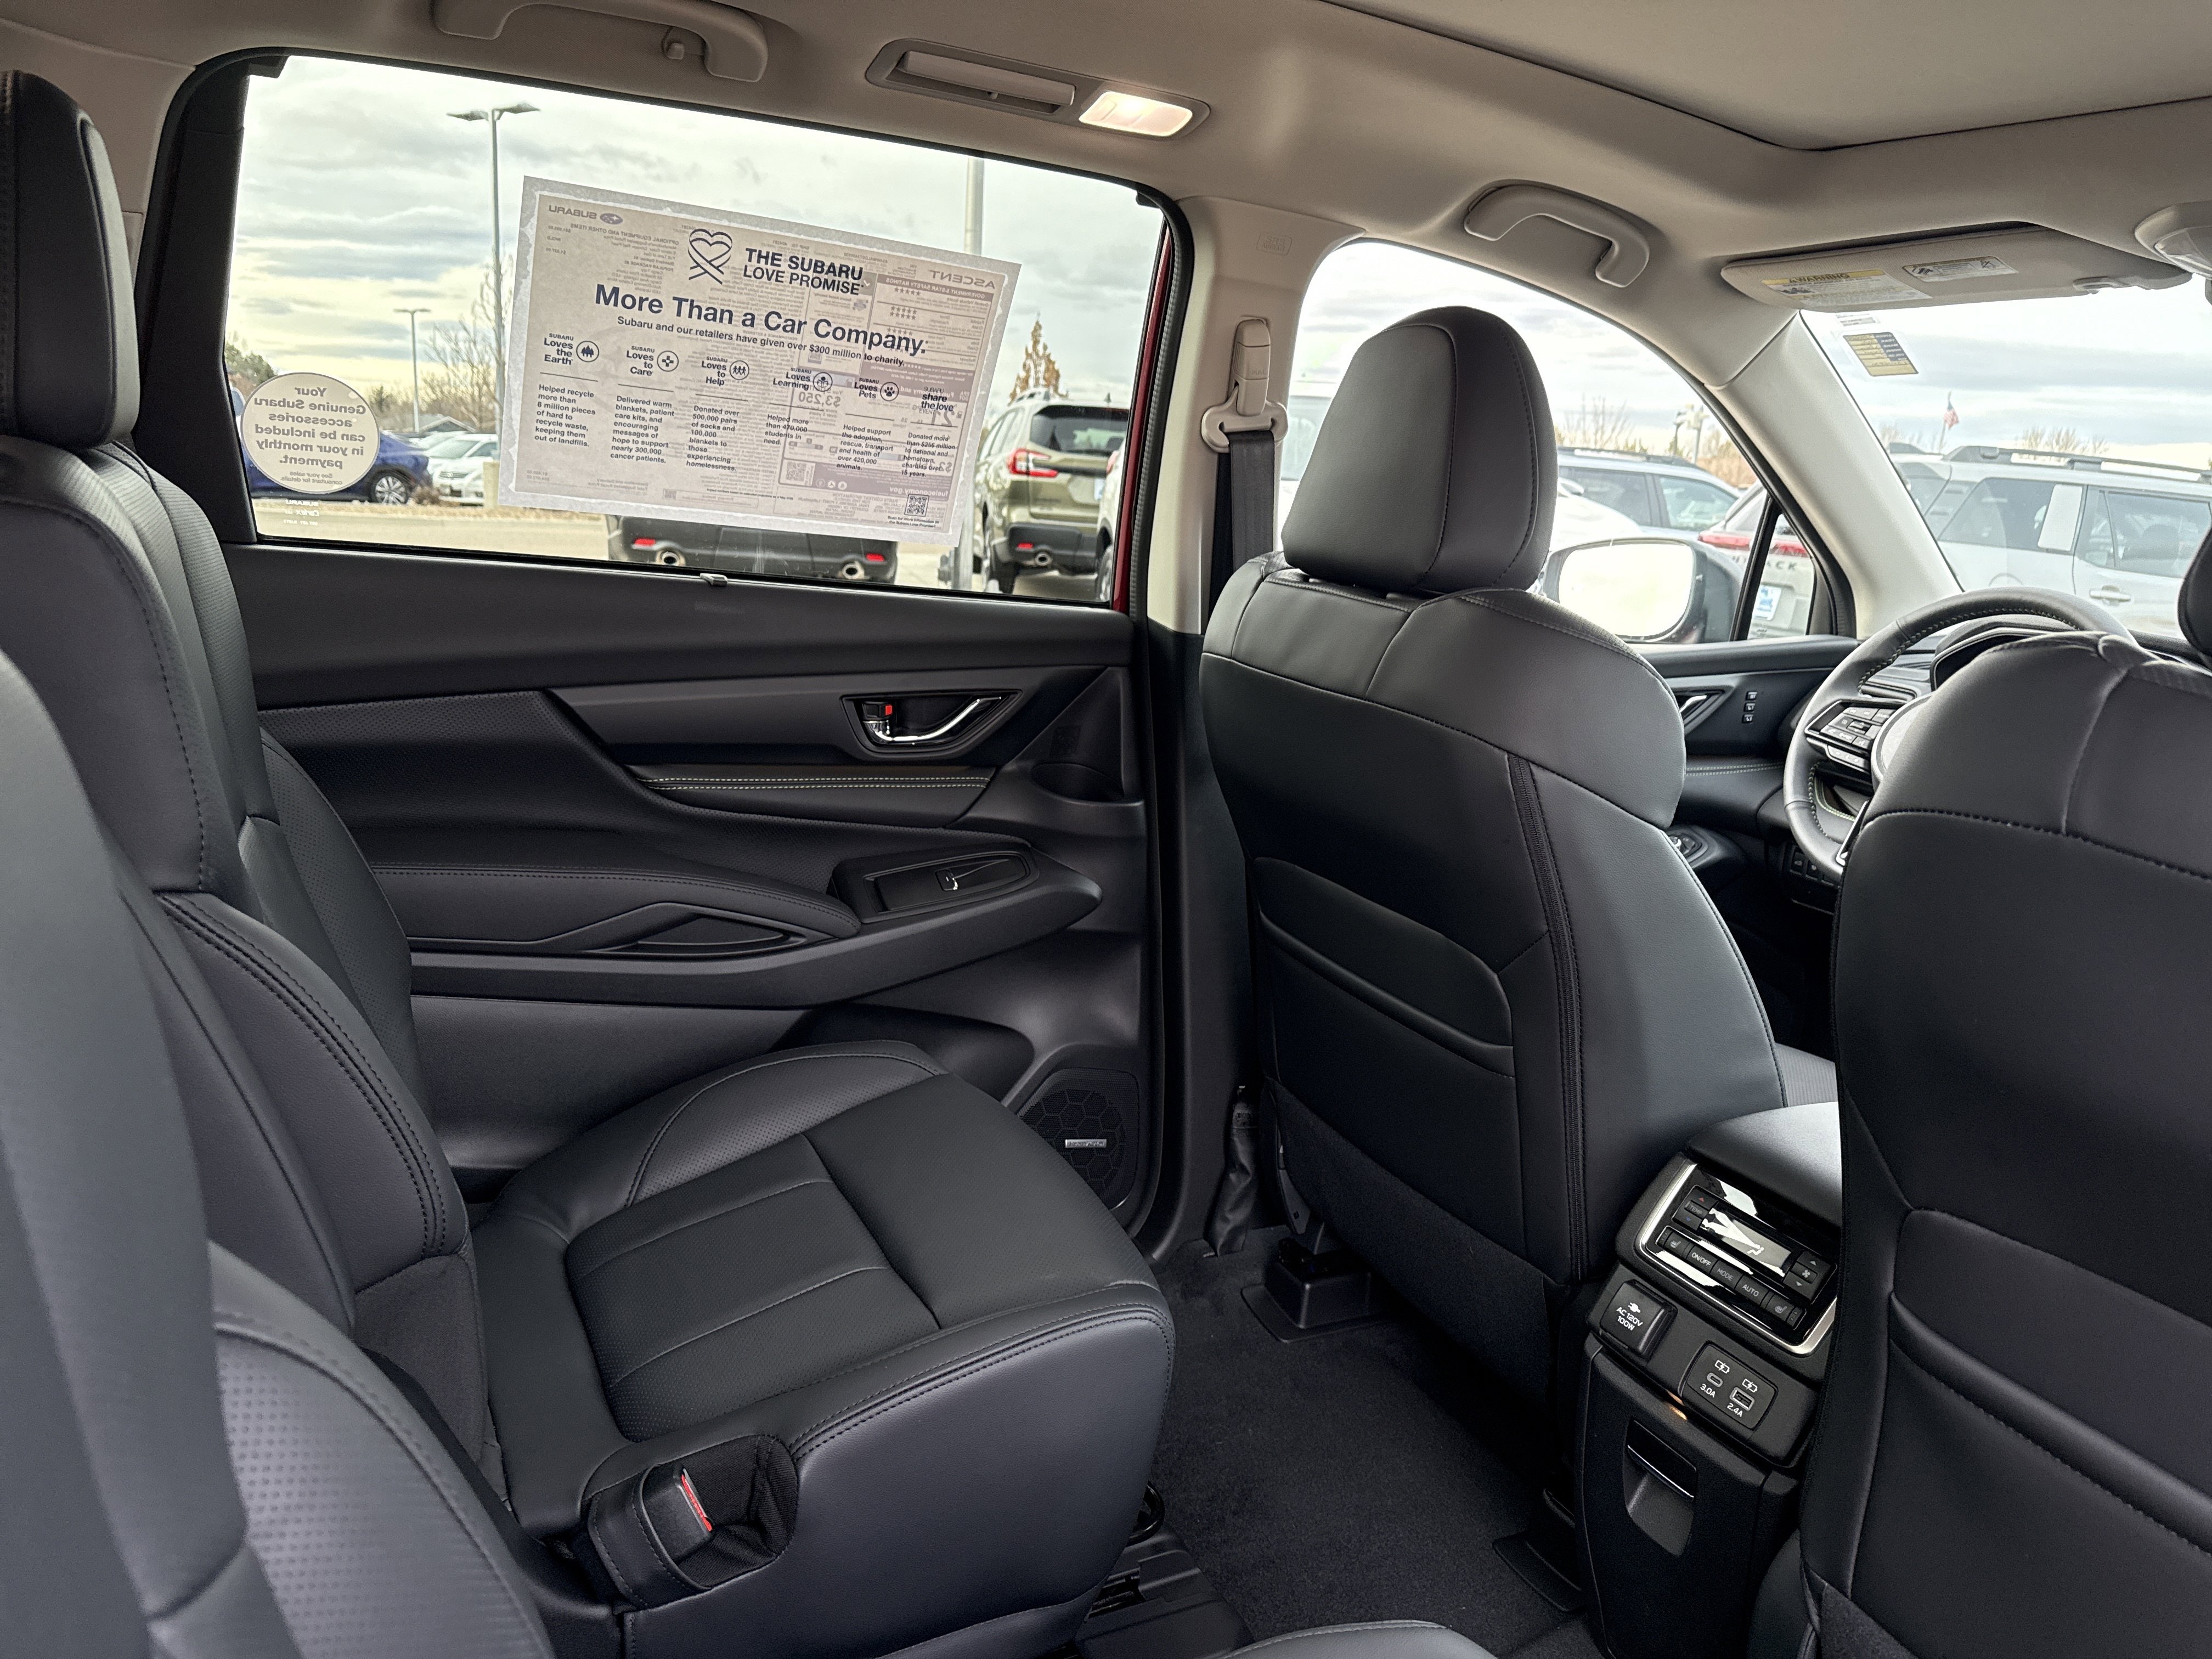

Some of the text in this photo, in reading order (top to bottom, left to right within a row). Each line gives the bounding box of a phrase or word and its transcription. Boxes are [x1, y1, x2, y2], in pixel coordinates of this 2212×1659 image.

[745, 247, 782, 267] THE
[787, 255, 863, 280] SUBARU
[743, 264, 862, 296] LOVE PROMISE
[595, 283, 663, 314] More
[672, 296, 733, 324] Than
[741, 312, 755, 328] a
[764, 311, 807, 334] Car
[814, 318, 928, 357] Company.
[549, 332, 574, 341] SUBARU
[617, 315, 653, 329] Subaru
[655, 323, 674, 332] and
[695, 329, 733, 340] retailers
[736, 333, 758, 344] have
[759, 337, 785, 348] given
[787, 342, 807, 351] over
[809, 343, 830, 354] $300
[543, 337, 573, 349] Loves
[556, 348, 572, 357] the
[626, 349, 654, 361] Loves
[544, 353, 572, 365] Earth
[701, 360, 726, 370] Loves
[629, 366, 652, 376] Care
[705, 376, 725, 386] Help
[785, 371, 810, 382] Loves
[772, 377, 809, 391] Learning
[853, 381, 878, 392] Loves
[538, 383, 594, 398] Helped recycle
[858, 390, 876, 399] Pets
[923, 386, 944, 394] SUBARU
[559, 396, 576, 404] than
[616, 395, 651, 405] Delivered
[922, 392, 947, 402] share
[571, 406, 596, 415] pieces
[615, 403, 648, 414] blankets,
[693, 405, 723, 414] Donated
[921, 400, 935, 409] the
[935, 402, 953, 411] love
[546, 410, 563, 419] hard
[632, 414, 647, 422] kits,
[692, 413, 719, 422] 500,000
[767, 414, 791, 424] Helped
[535, 419, 589, 431] recycle waste,
[613, 421, 658, 432] encouraging
[782, 424, 808, 432] 470,000
[843, 424, 866, 432] Helped
[535, 426, 585, 438] keeping them
[612, 429, 649, 438] messages
[691, 428, 716, 437] 100,000
[764, 430, 793, 439] students
[907, 432, 933, 440] Donated
[558, 437, 589, 447] landfills.
[612, 436, 630, 444] hope
[641, 440, 669, 448] support
[689, 437, 718, 445] blankets
[853, 434, 883, 443] adoption,
[611, 445, 662, 455] nearly 300,000
[688, 444, 708, 453] those
[840, 440, 893, 452] rescue, transport
[912, 448, 936, 456] national
[686, 453, 731, 464] experiencing
[853, 456, 877, 465] 420,000
[1691, 1252, 1711, 1266] ON/OFF
[1717, 1268, 1734, 1281] MODE
[1742, 1284, 1759, 1297] AUTO
[1616, 1307, 1643, 1327] AC 120V
[1618, 1316, 1635, 1330] 100W
[1700, 1384, 1716, 1398] 3.0A
[1727, 1403, 1743, 1418] 2.4A
